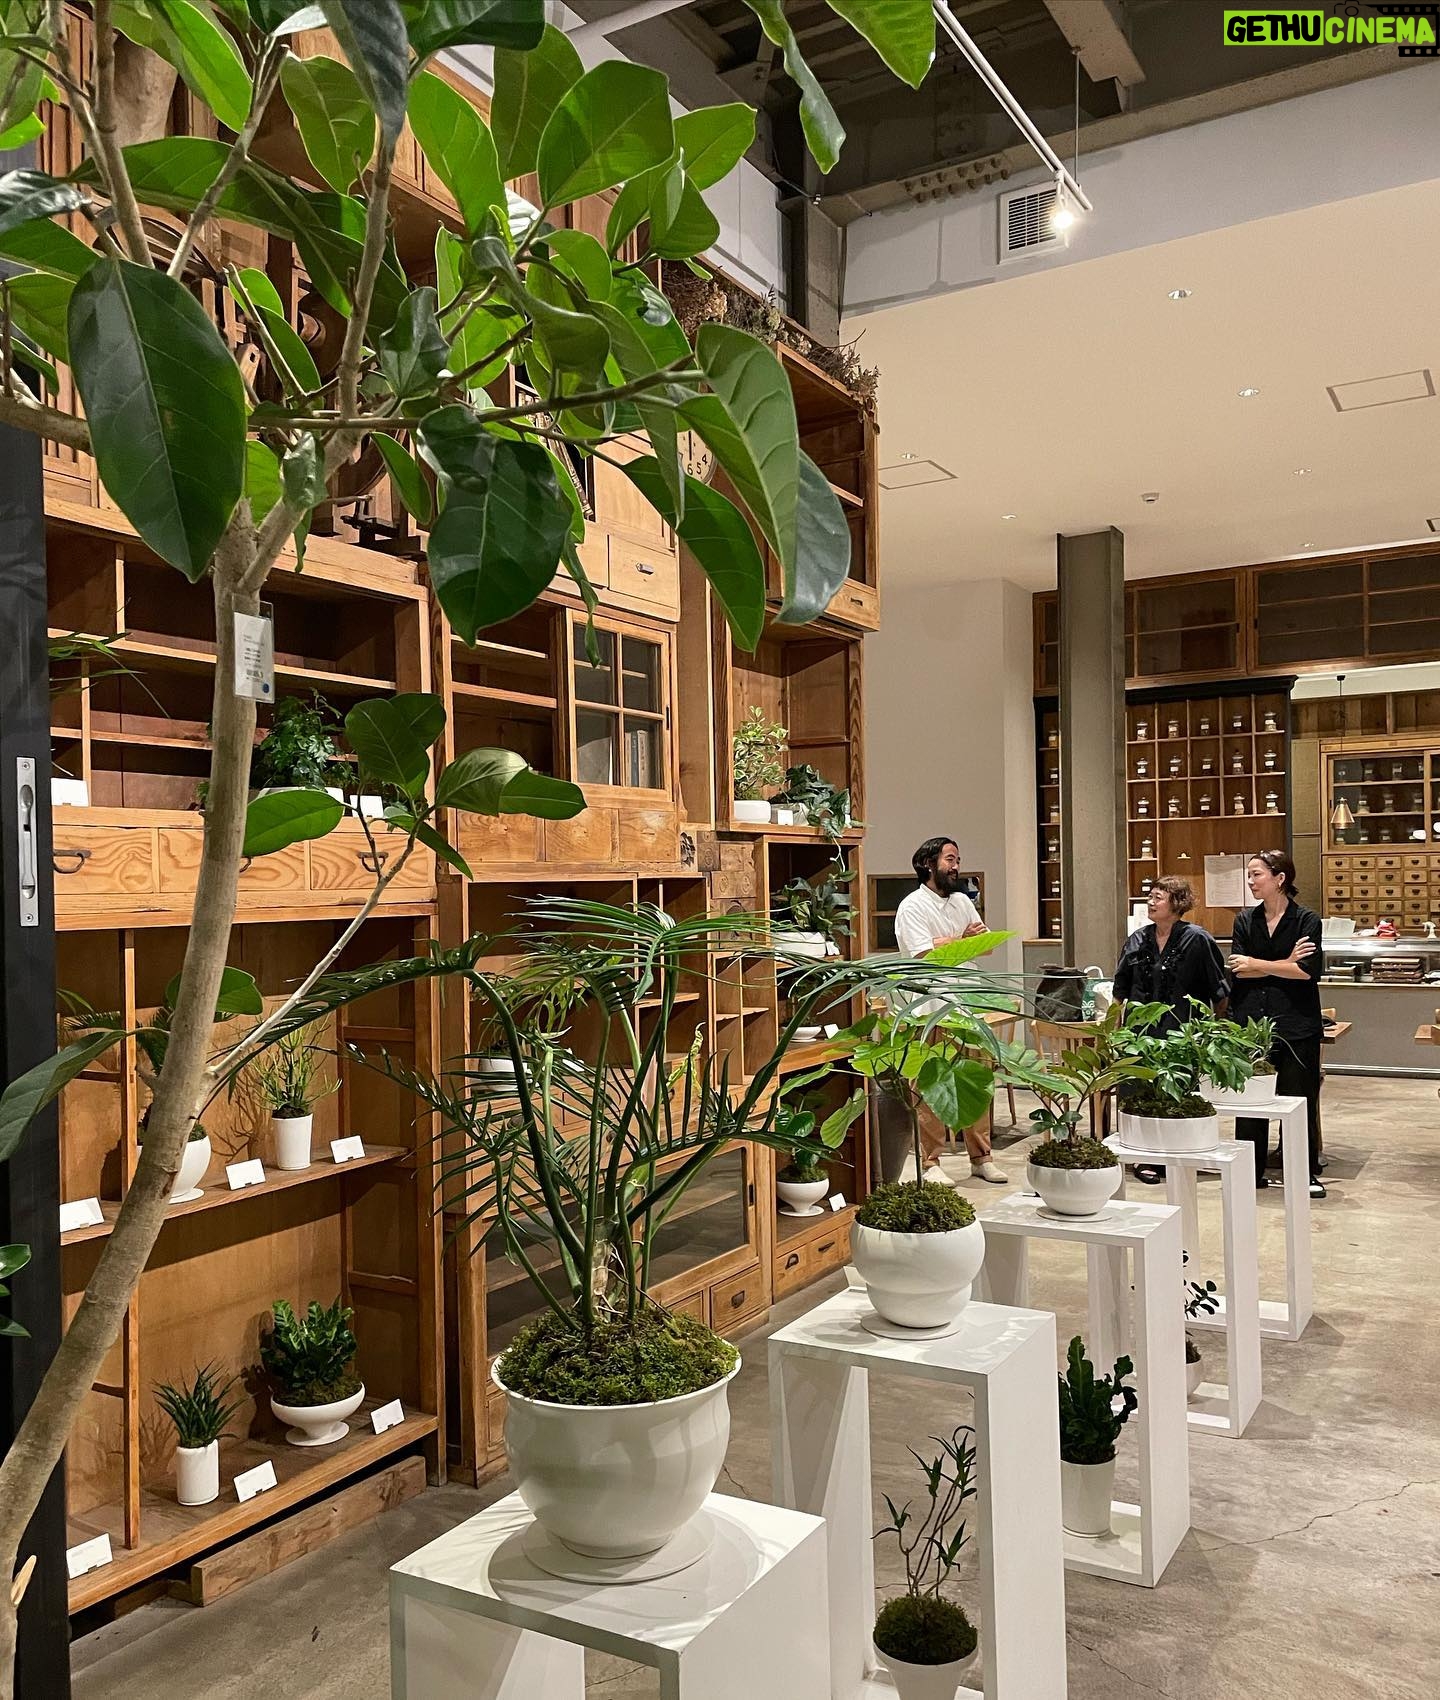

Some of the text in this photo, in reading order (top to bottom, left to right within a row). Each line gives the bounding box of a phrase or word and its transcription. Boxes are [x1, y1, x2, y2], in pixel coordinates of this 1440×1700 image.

[701, 453, 708, 465] 4
[687, 463, 693, 475] 6
[696, 461, 702, 475] 5
